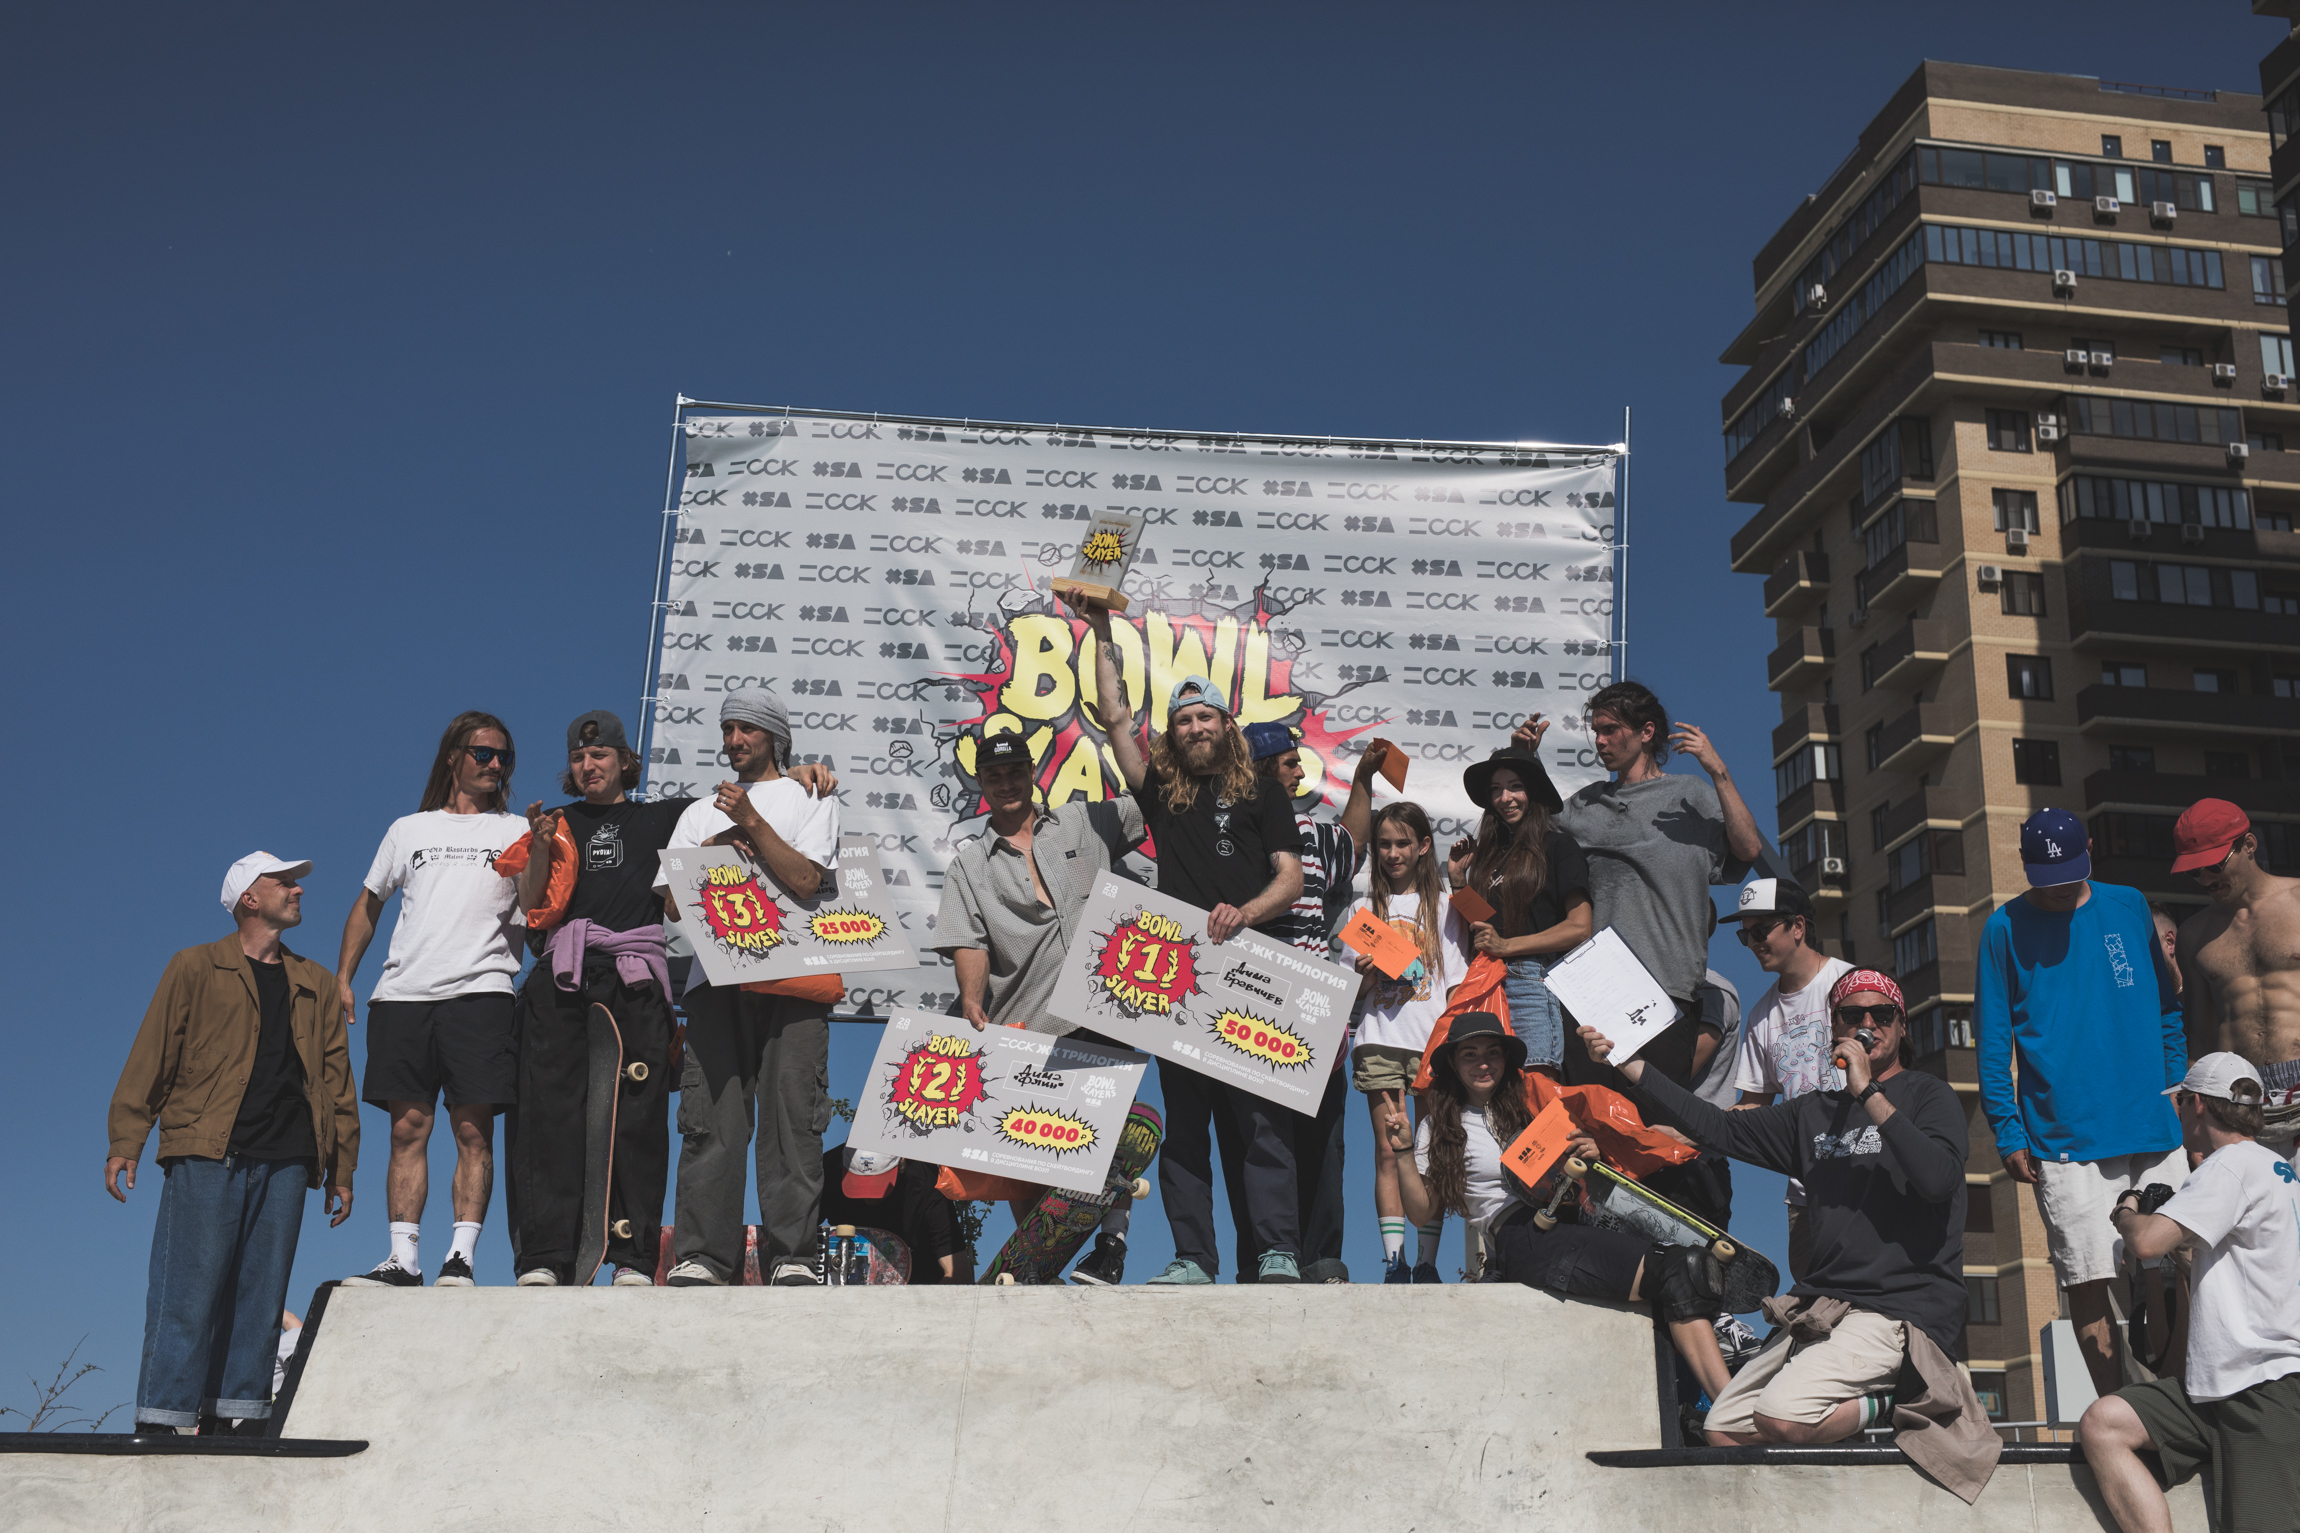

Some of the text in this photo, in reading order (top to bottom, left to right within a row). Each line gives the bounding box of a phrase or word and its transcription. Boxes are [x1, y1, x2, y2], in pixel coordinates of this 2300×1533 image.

[1092, 533, 1120, 548] BOWL
[1083, 543, 1122, 561] SLAYER
[2045, 838, 2062, 858] LA
[670, 858, 683, 867] 28
[707, 865, 748, 886] BOWL
[844, 868, 869, 881] BOWL
[844, 878, 873, 890] SLAYERS
[1103, 882, 1119, 894] 28
[726, 893, 752, 927] 3
[819, 919, 871, 935] 25 000
[1137, 910, 1184, 942] BOWL
[726, 927, 784, 950] SLAYER
[1133, 943, 1163, 981] 1
[1275, 952, 1348, 991] ТРИЛОГИЯ
[1105, 974, 1171, 1014] SLAYER
[1300, 988, 1331, 1009] BOWL
[1295, 998, 1331, 1018] SLAYERS
[898, 1017, 911, 1026] 28
[928, 1034, 971, 1058] BOWL
[1224, 1019, 1296, 1058] 50 000
[1036, 1043, 1060, 1057] ЖК
[1062, 1048, 1135, 1072] ТРИЛОГИЯ
[921, 1062, 952, 1101] 2
[1081, 1085, 1117, 1099] SLAYERS
[1087, 1075, 1117, 1090] BOWL
[898, 1097, 959, 1125] SLAYER
[1010, 1118, 1079, 1142] 40 000
